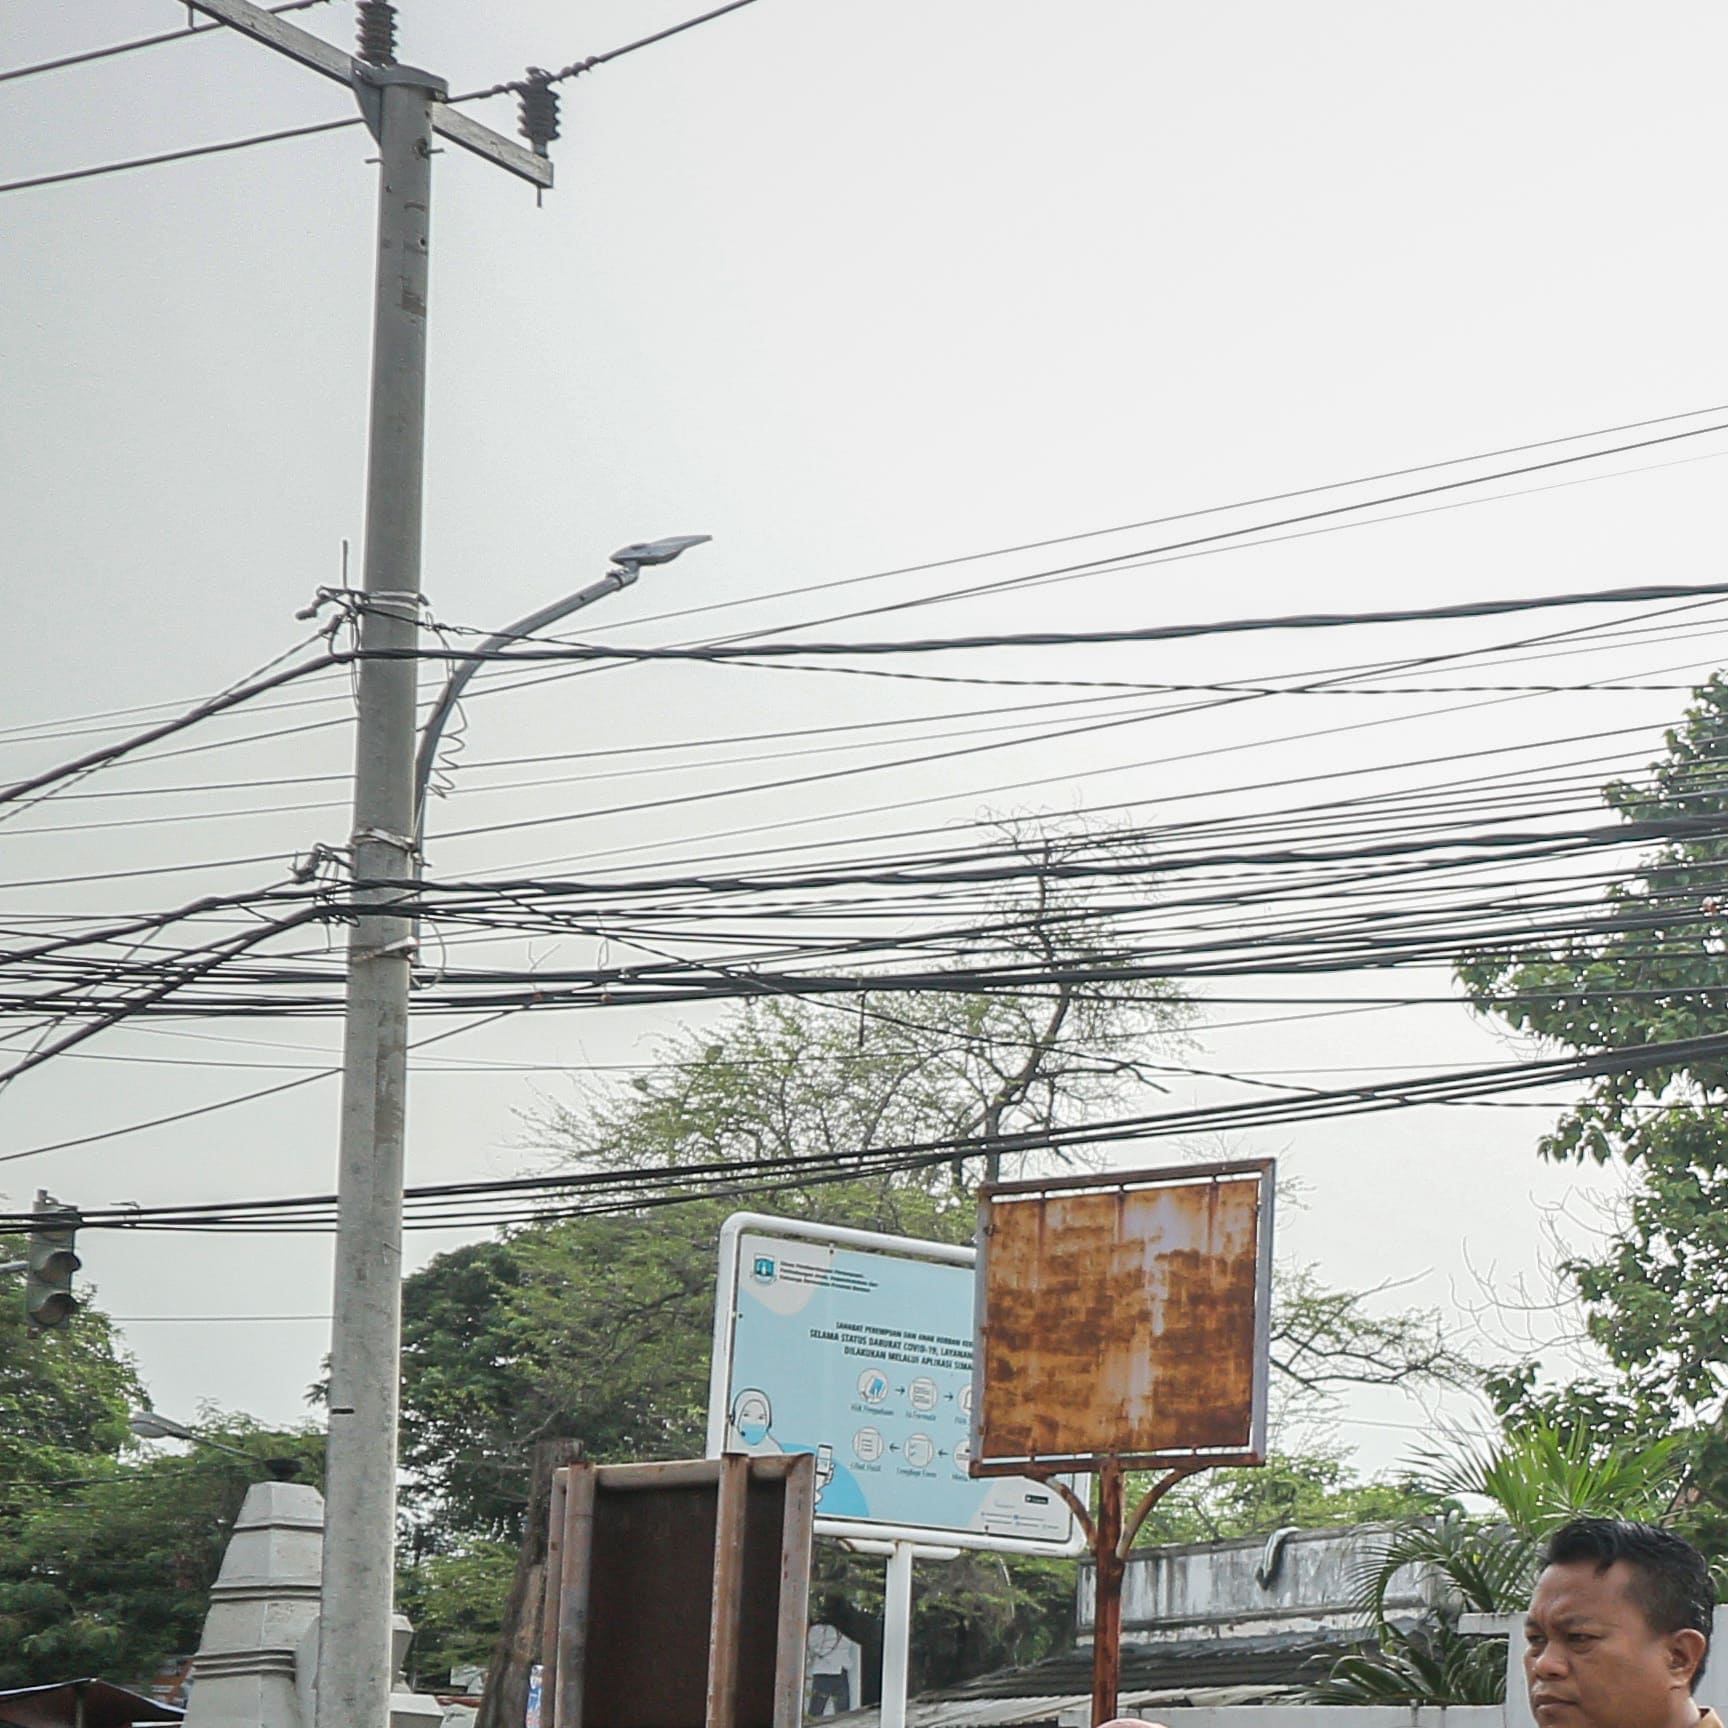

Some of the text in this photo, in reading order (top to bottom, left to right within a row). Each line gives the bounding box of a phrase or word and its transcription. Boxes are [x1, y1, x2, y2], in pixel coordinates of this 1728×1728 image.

[810, 1329, 839, 1341] SELAMA
[841, 1333, 867, 1345] STATUS
[844, 1346, 886, 1360] DILAKUKAN
[888, 1352, 919, 1364] MELALUI
